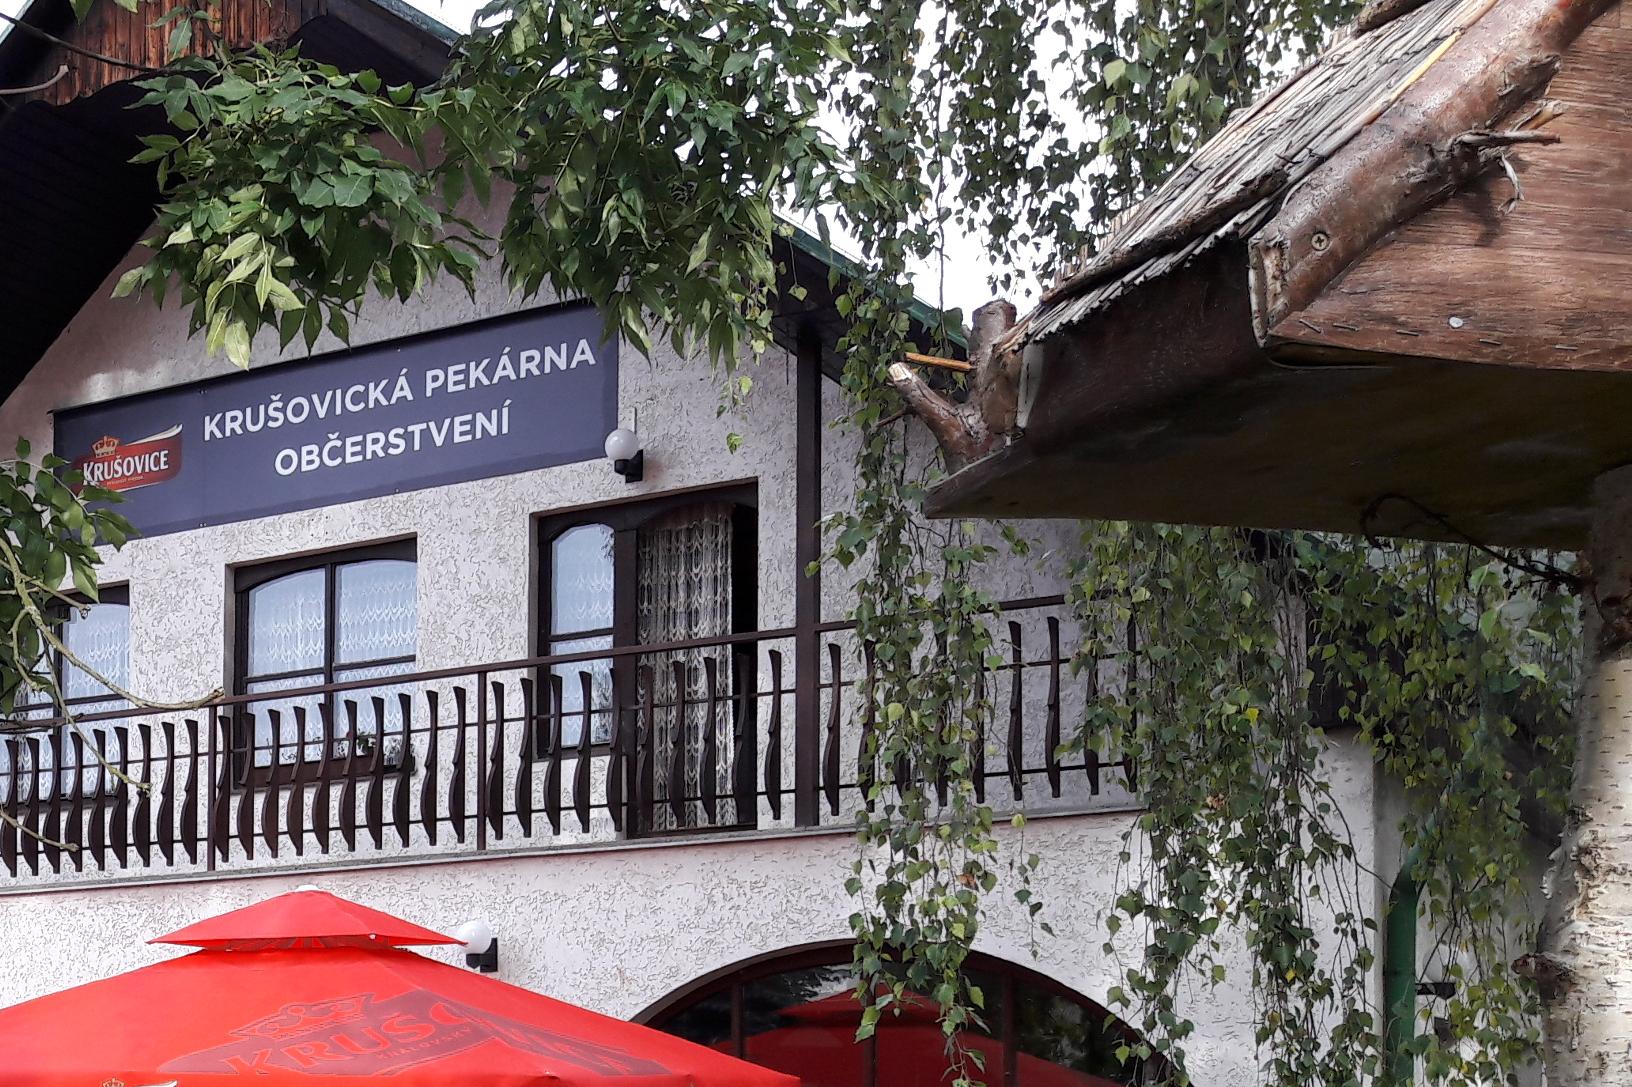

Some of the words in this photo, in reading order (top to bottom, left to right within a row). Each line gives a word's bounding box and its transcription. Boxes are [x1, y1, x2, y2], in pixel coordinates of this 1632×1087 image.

[203, 368, 413, 441] KRUŠOVICKÁ
[425, 338, 596, 397] PEKÁRNA
[83, 450, 169, 486] KRUŠOVICE
[274, 399, 512, 476] OBČERSTVENÍ
